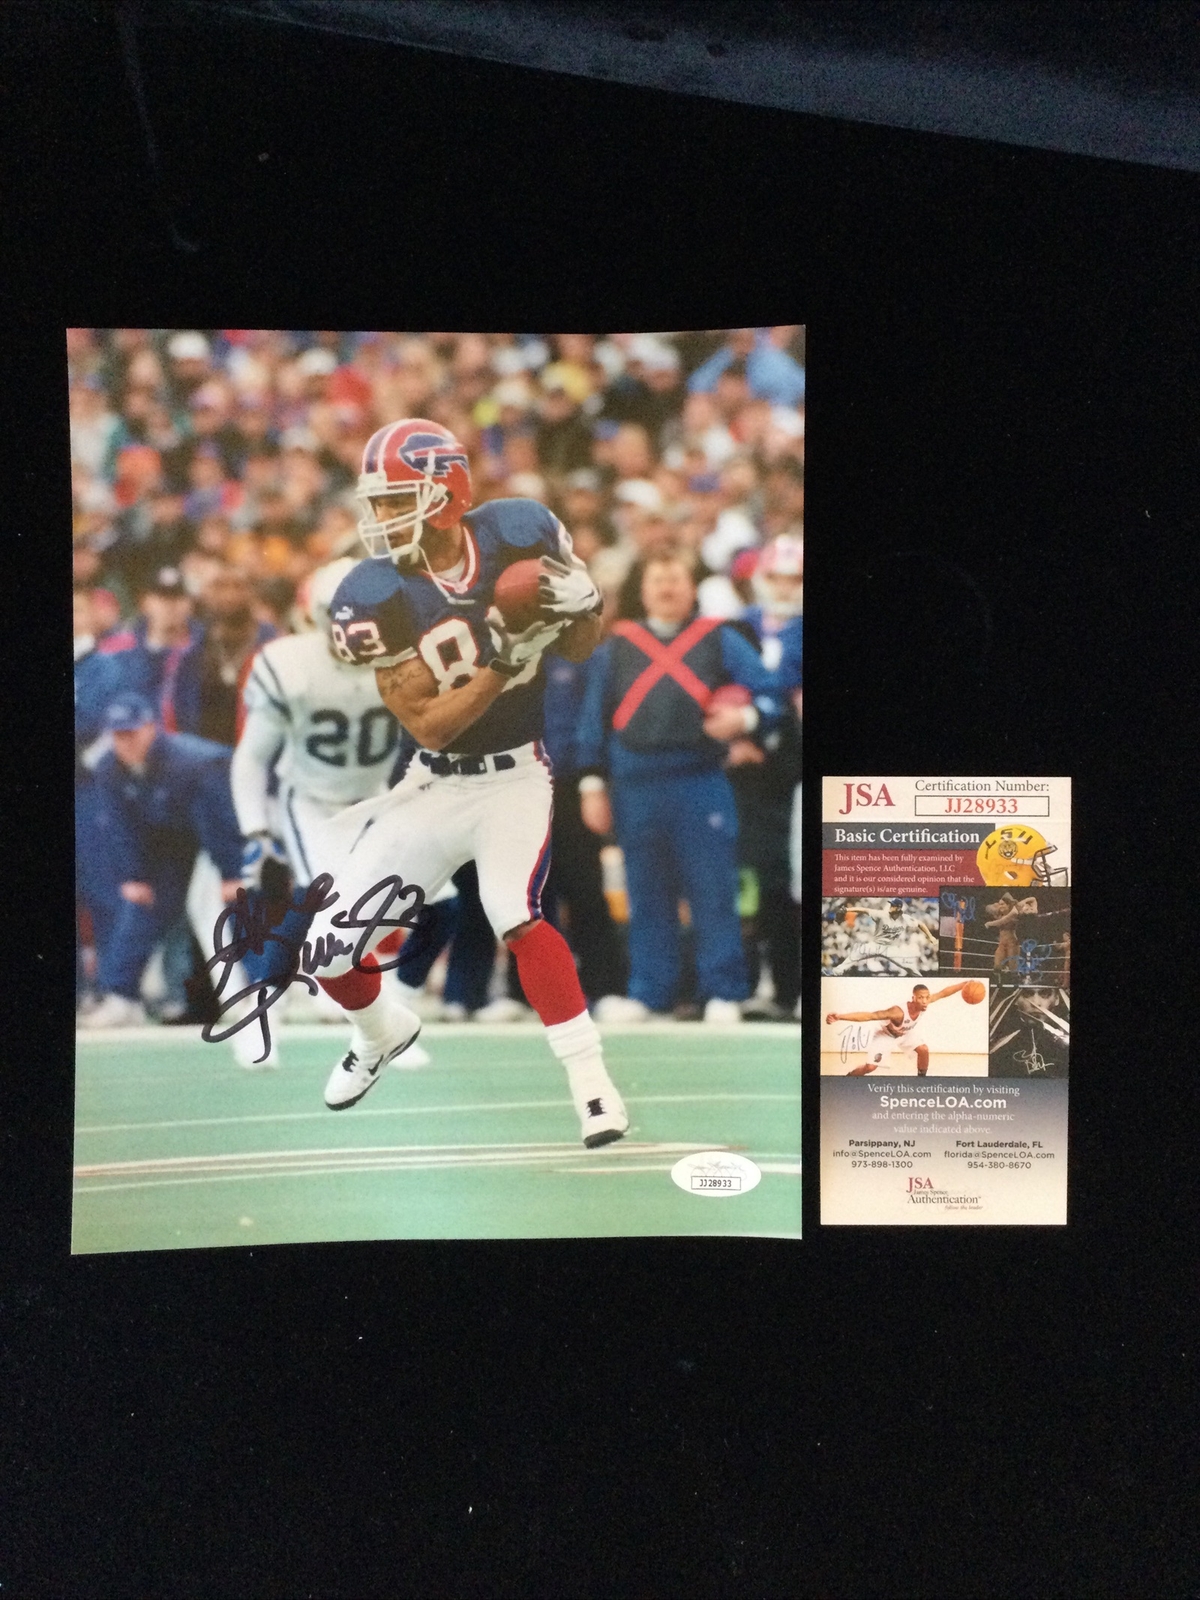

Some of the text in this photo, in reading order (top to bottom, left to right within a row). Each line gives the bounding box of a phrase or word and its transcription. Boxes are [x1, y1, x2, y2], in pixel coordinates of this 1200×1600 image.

[306, 706, 400, 768] 20
[915, 780, 1050, 793] Certification Number:
[839, 783, 896, 815] JSA
[945, 798, 1019, 814] JJ28933
[835, 828, 981, 845] Basic Certification
[835, 853, 964, 864] This item has been fully examined by
[834, 864, 855, 872] James
[856, 864, 881, 873] Spence
[883, 864, 938, 873] Authentication,
[834, 874, 848, 882] and
[877, 875, 916, 883] considered
[917, 875, 946, 884] opinion
[947, 875, 961, 883] that
[963, 875, 975, 883] the
[834, 885, 928, 895] signature(s) is/are genuine.
[867, 1084, 1020, 1096] Verify this certification by visiting
[880, 1096, 1007, 1110] SpenceLOA.com
[872, 1111, 1015, 1123] and entering the alpha-numeric
[893, 1124, 993, 1135] value indicated above.
[848, 1139, 916, 1149] Parsippany, NJ
[955, 1141, 1043, 1150] Fort Lauderdale, FL
[832, 1150, 932, 1159] info@SpenceLOA.com
[944, 1151, 1055, 1160] florida@SpenceLOA.com
[851, 1160, 913, 1169] 973-898-1300
[967, 1161, 1032, 1170] 954-380-8670
[906, 1176, 934, 1193] JSA
